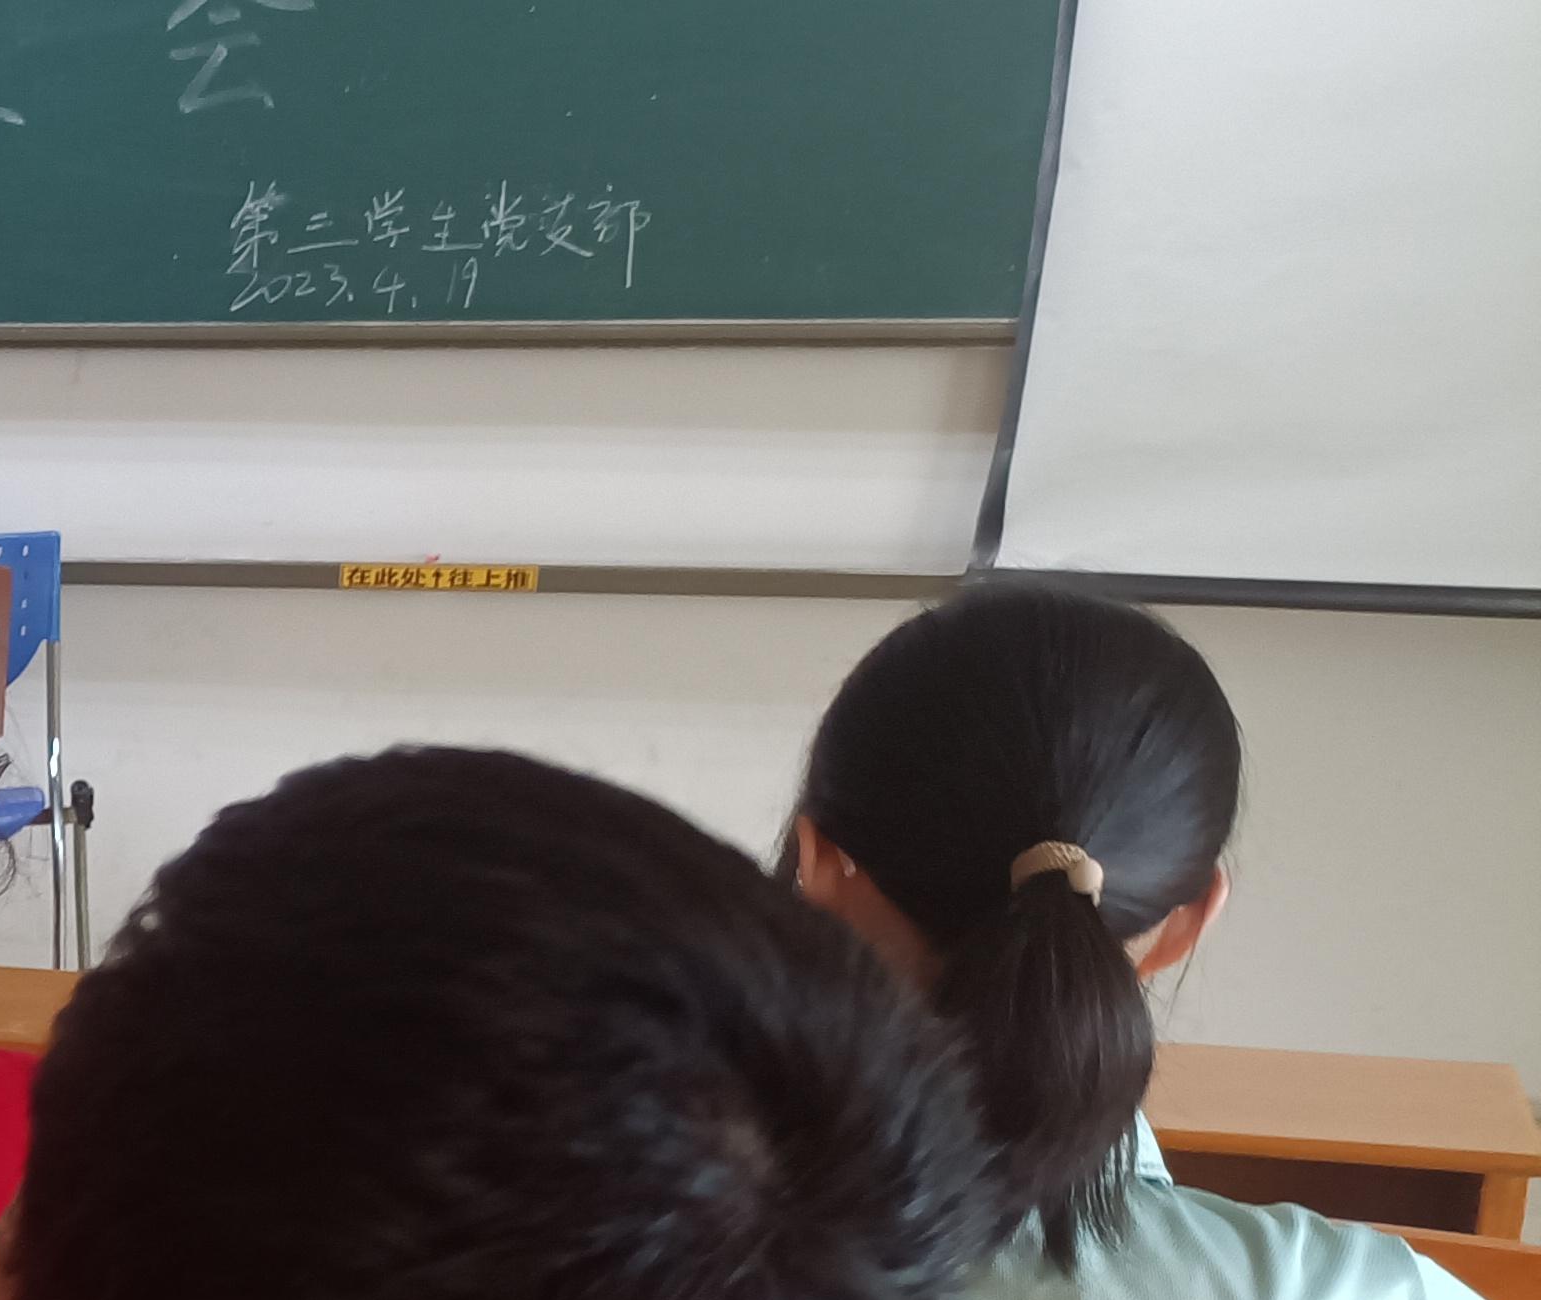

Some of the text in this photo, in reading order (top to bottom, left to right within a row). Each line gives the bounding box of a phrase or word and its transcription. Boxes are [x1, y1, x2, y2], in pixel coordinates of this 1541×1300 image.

[226, 180, 652, 289] 第三学生党支部
